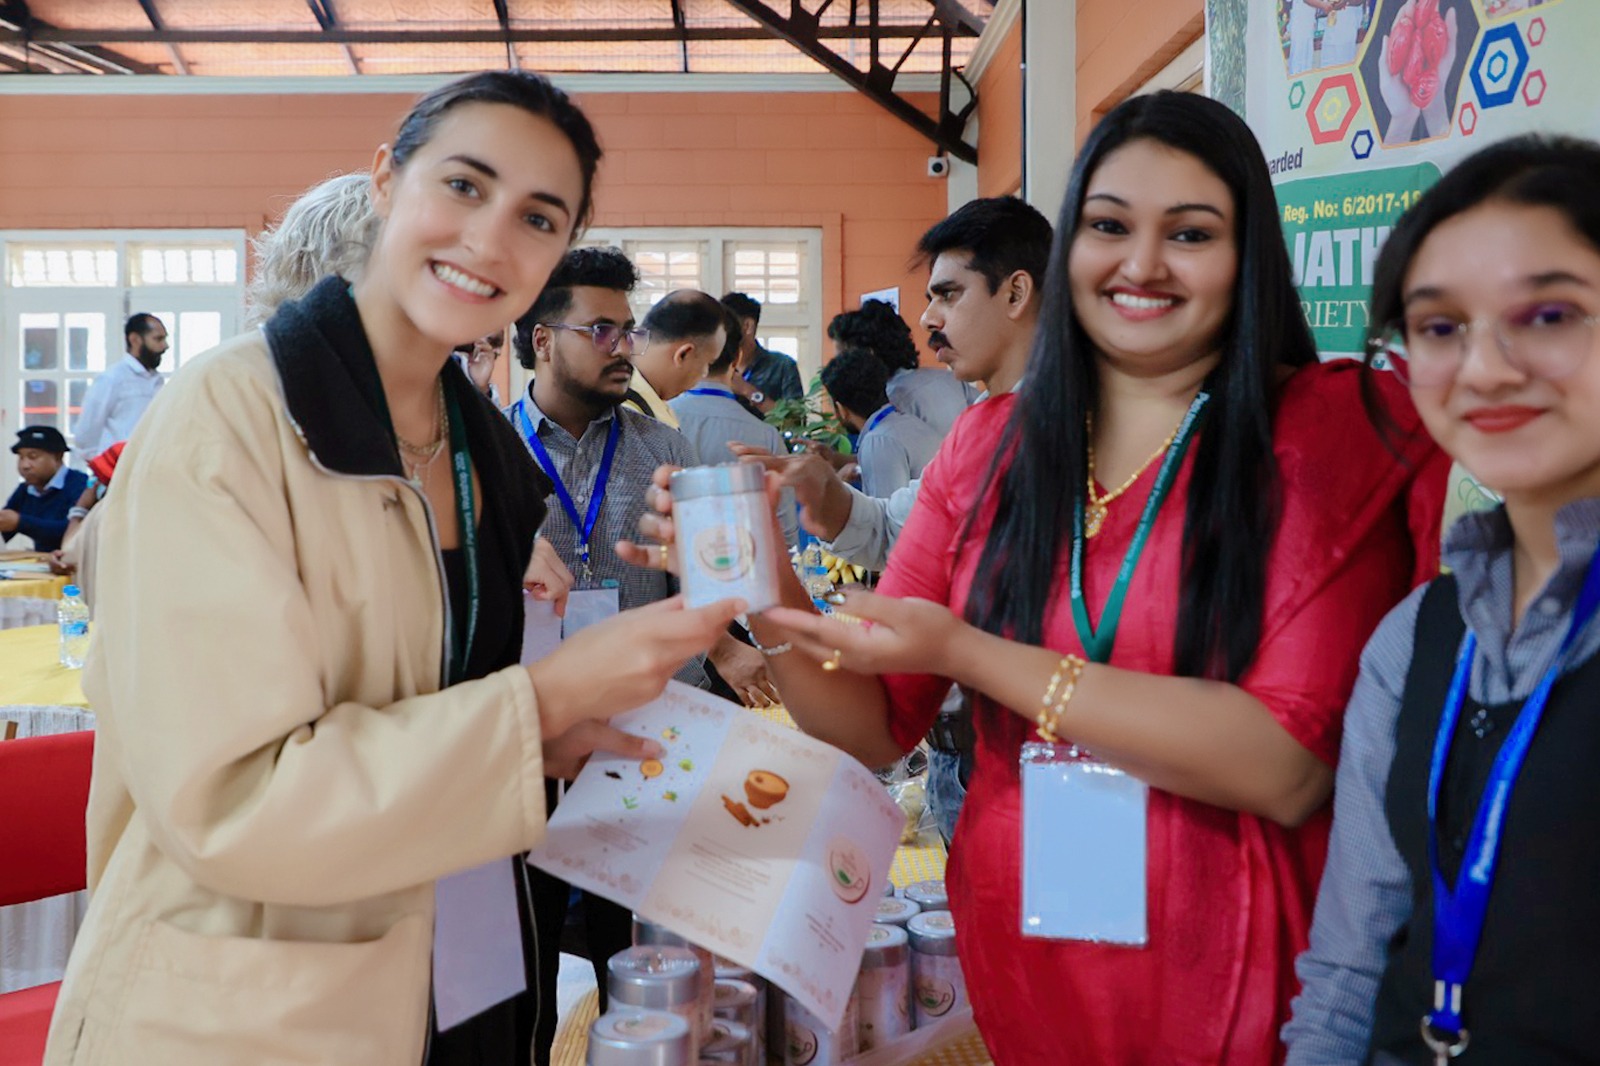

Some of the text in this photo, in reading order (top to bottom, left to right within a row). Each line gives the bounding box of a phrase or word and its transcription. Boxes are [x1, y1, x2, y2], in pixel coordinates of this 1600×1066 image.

[1269, 147, 1303, 175] arded
[1284, 204, 1309, 224] Reg.
[1314, 200, 1339, 219] No:
[1292, 226, 1394, 287] JATH
[459, 471, 471, 510] Workshop
